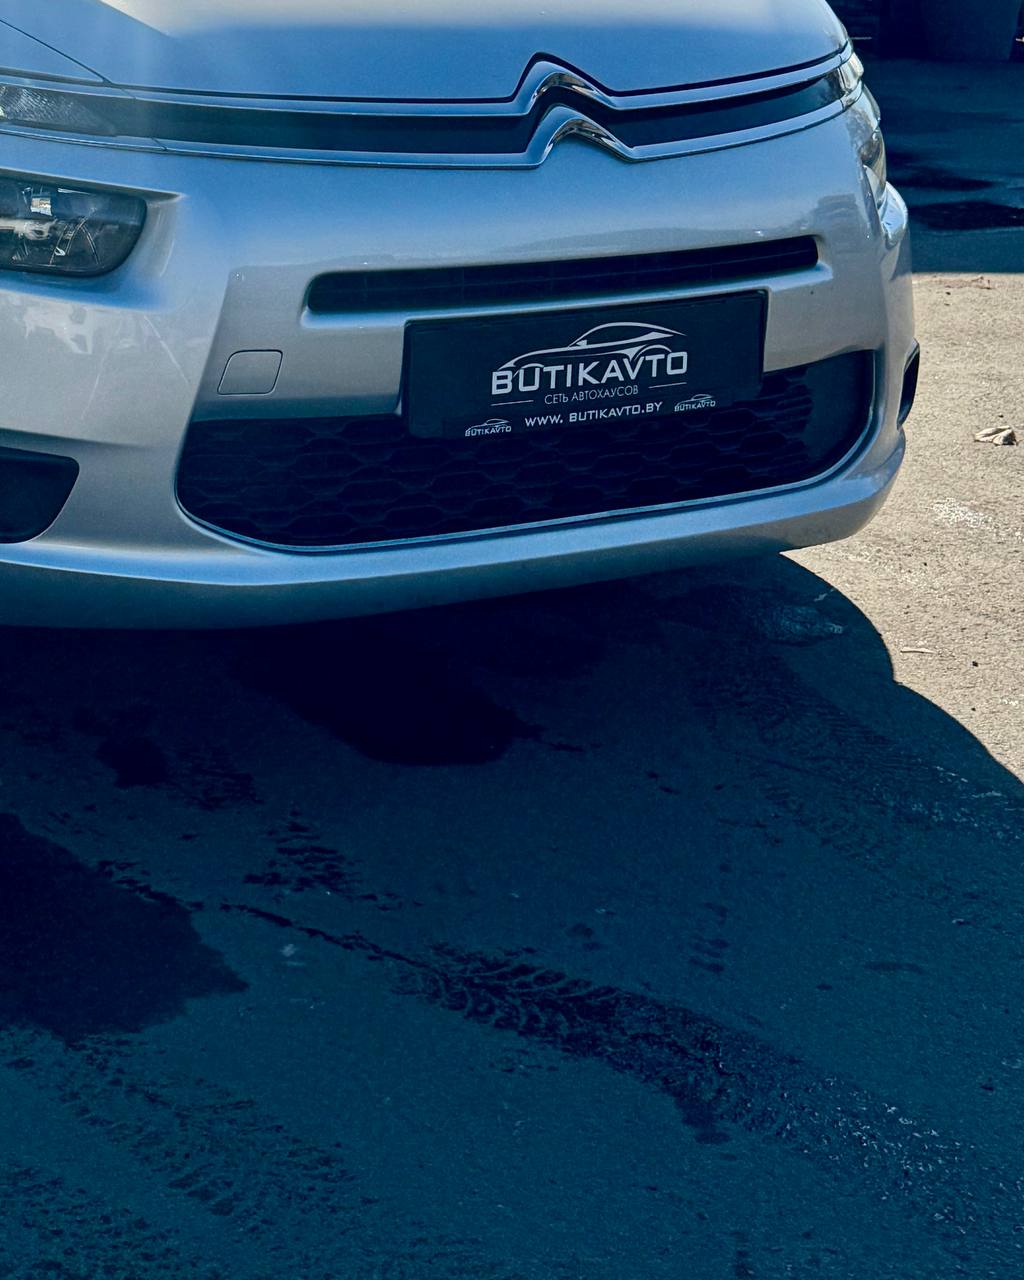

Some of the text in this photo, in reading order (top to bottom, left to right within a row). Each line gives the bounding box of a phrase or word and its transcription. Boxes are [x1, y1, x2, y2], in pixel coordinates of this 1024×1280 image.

[491, 351, 688, 395] BUTIKAVTO
[544, 384, 639, 405] СЕТЬ АВТОХАУСОВ
[464, 426, 512, 437] BUTIKAVTO
